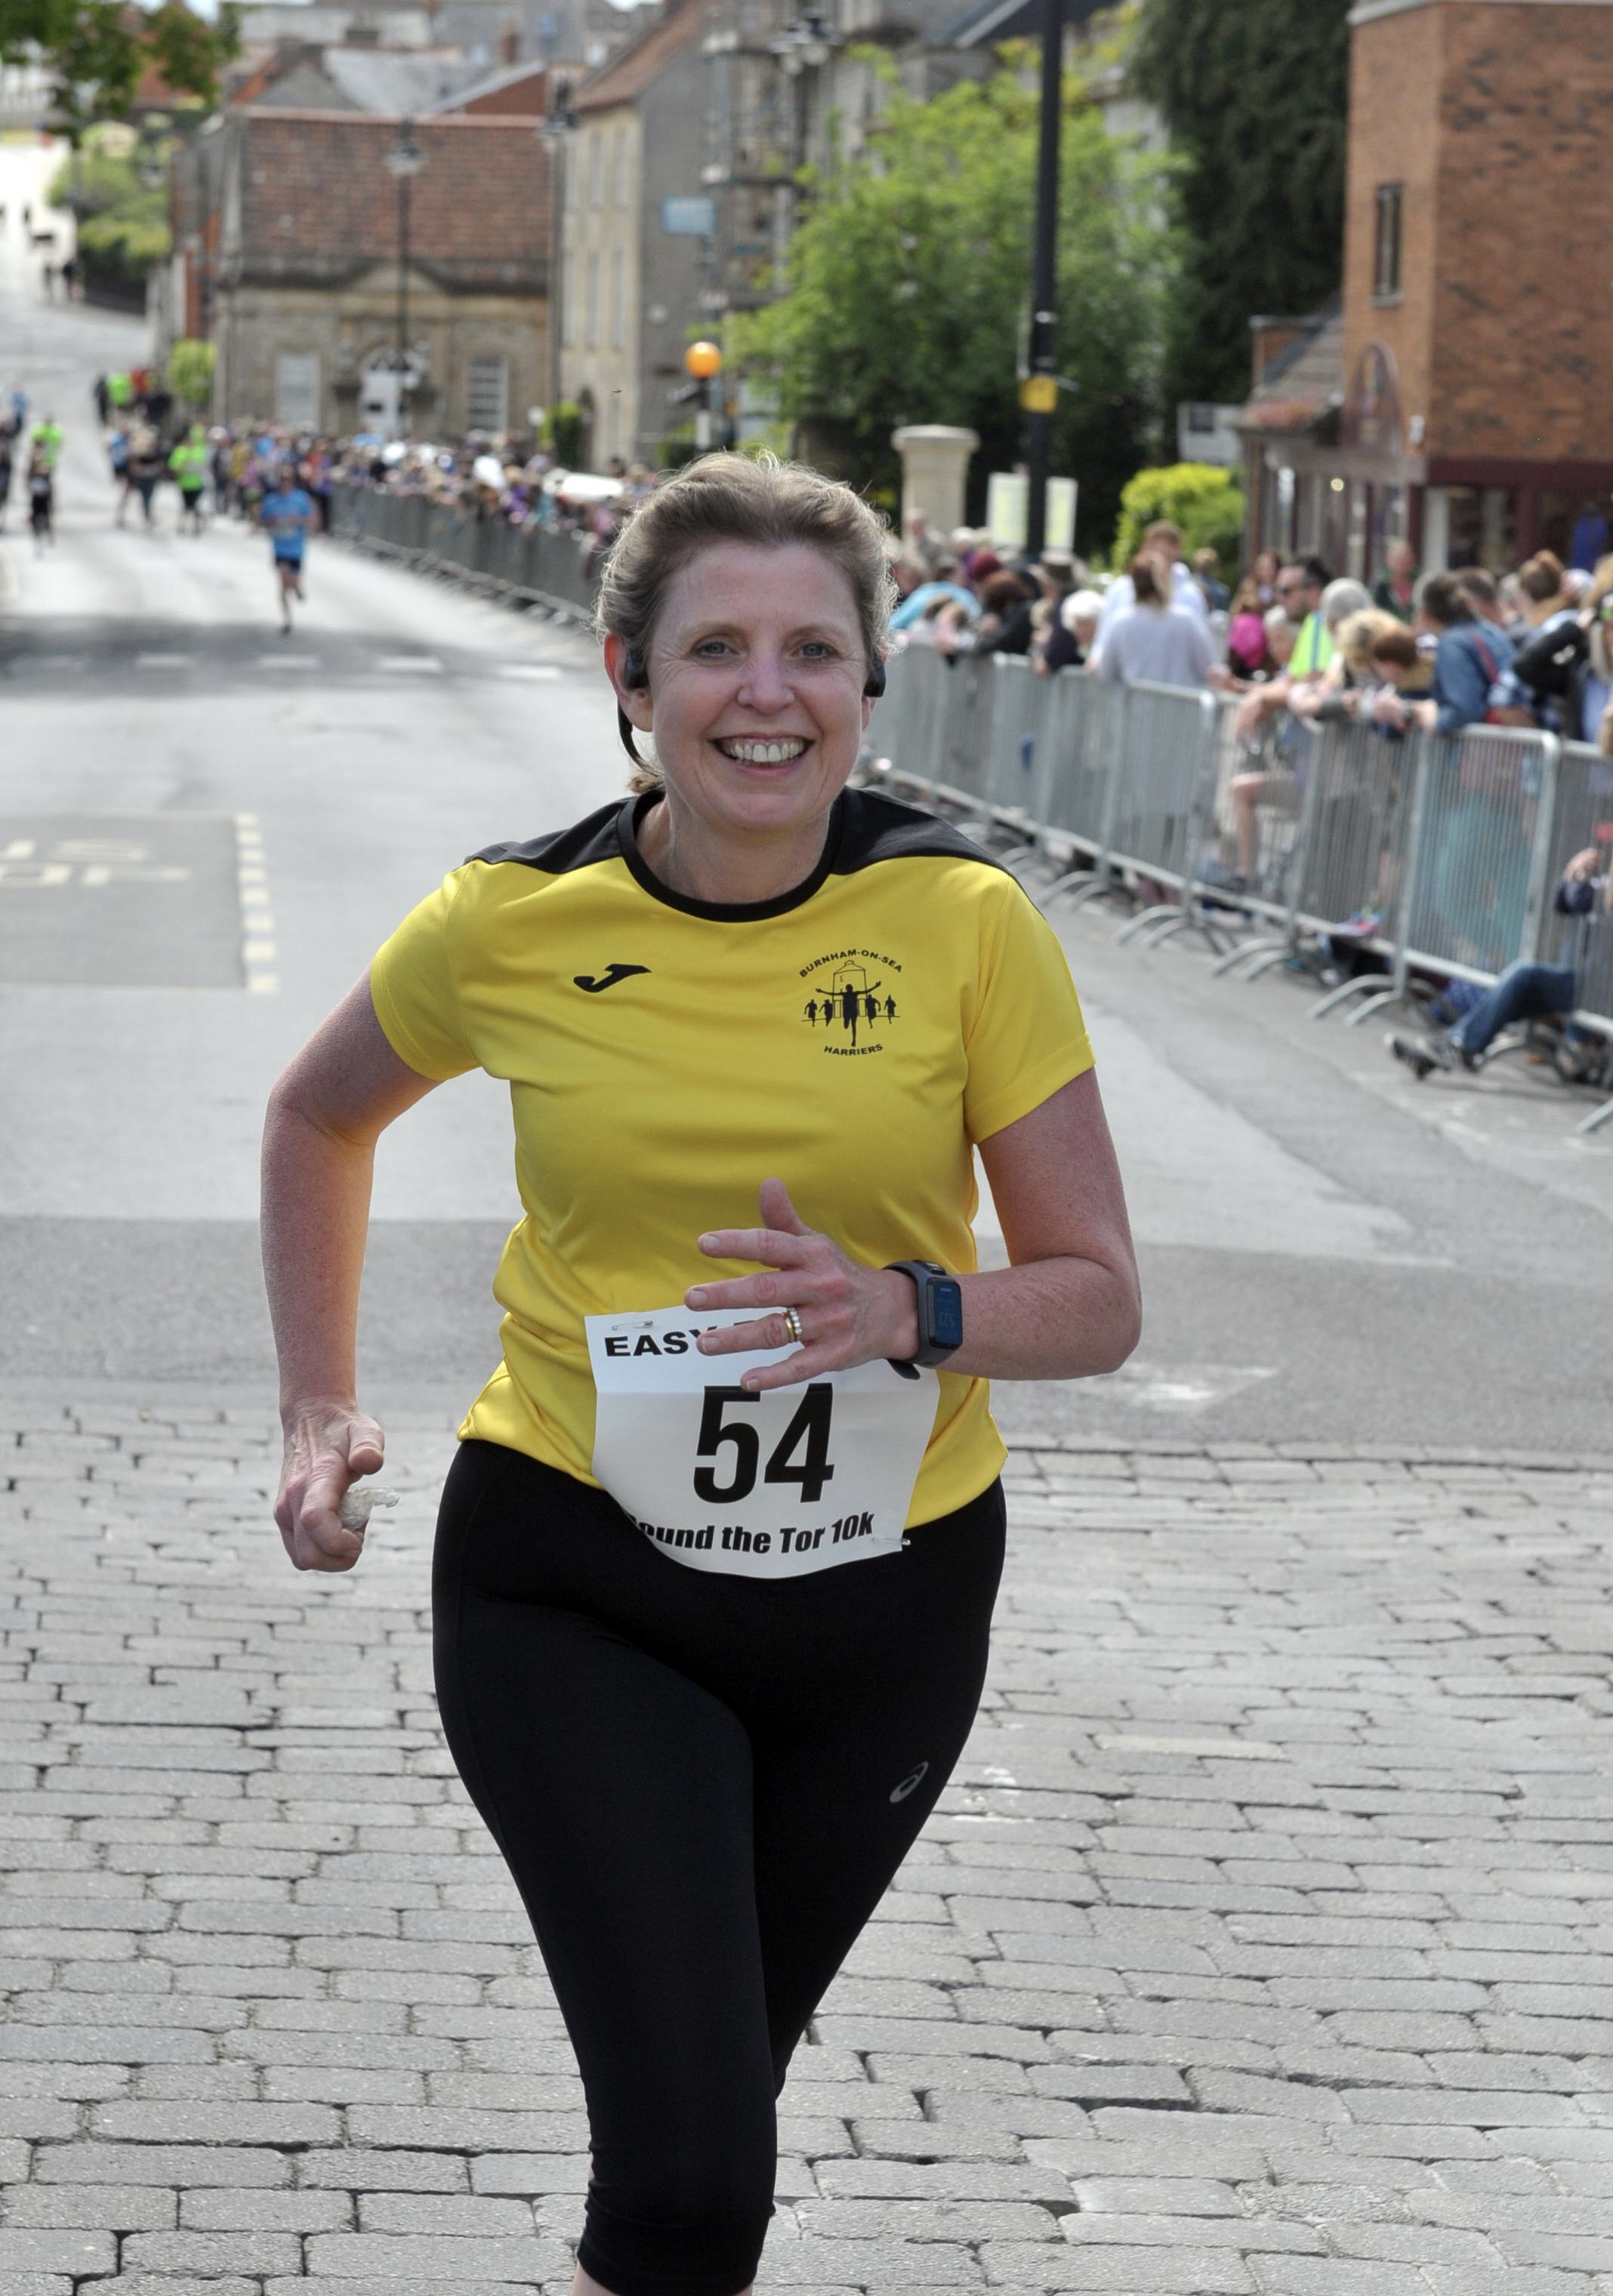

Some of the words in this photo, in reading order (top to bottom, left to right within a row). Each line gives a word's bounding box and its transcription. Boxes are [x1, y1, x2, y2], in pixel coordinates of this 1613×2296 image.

[799, 949, 902, 978] BURNHAM-ON-SEA
[824, 1044, 884, 1056] HARRIERS
[693, 1383, 834, 1504] 54
[625, 1513, 715, 1550] ound
[721, 1526, 771, 1554] the
[779, 1527, 826, 1554] Tor
